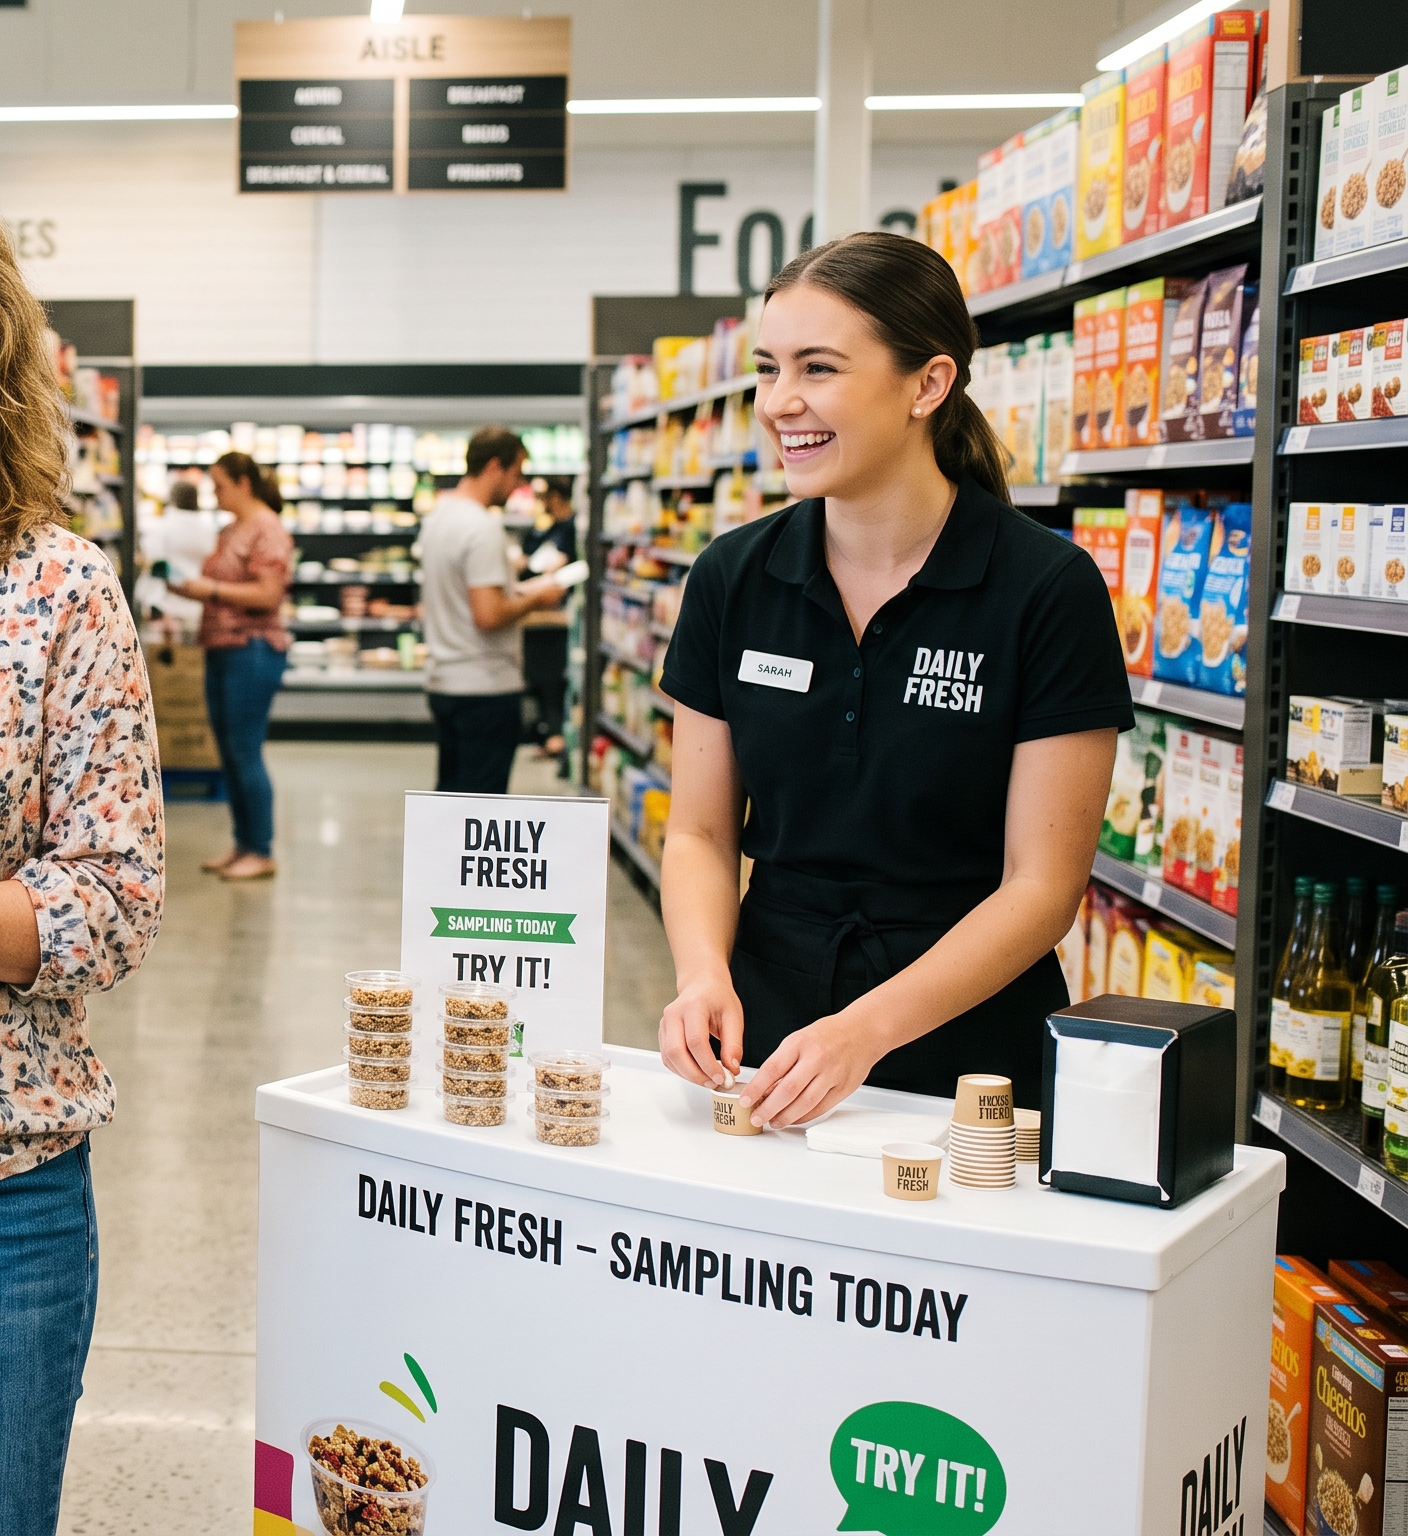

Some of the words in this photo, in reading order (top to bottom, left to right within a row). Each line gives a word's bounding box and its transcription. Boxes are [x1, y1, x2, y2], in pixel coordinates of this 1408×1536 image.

[360, 34, 446, 62] AISLE
[757, 663, 792, 679] SARAH
[912, 647, 985, 682] DAILY
[903, 676, 983, 713] FRESH
[464, 818, 546, 855] DAILY
[460, 855, 548, 891] FRESH
[447, 915, 513, 935] SAMPLING
[516, 918, 557, 938] TODAY
[452, 952, 508, 986] TRY
[516, 957, 551, 990] IT!
[897, 1165, 929, 1180] DAILY
[897, 1178, 930, 1192] FRESH
[358, 1173, 444, 1237] DAILY
[454, 1198, 562, 1266] FRESH
[609, 1230, 814, 1318] SAMPLING
[830, 1272, 969, 1344] TODAY
[1316, 1365, 1367, 1439] Cheerios
[494, 1404, 774, 1536] DAILY
[849, 1437, 925, 1498] TRY
[935, 1457, 988, 1514] IT!
[1179, 1414, 1247, 1536] DAILY
